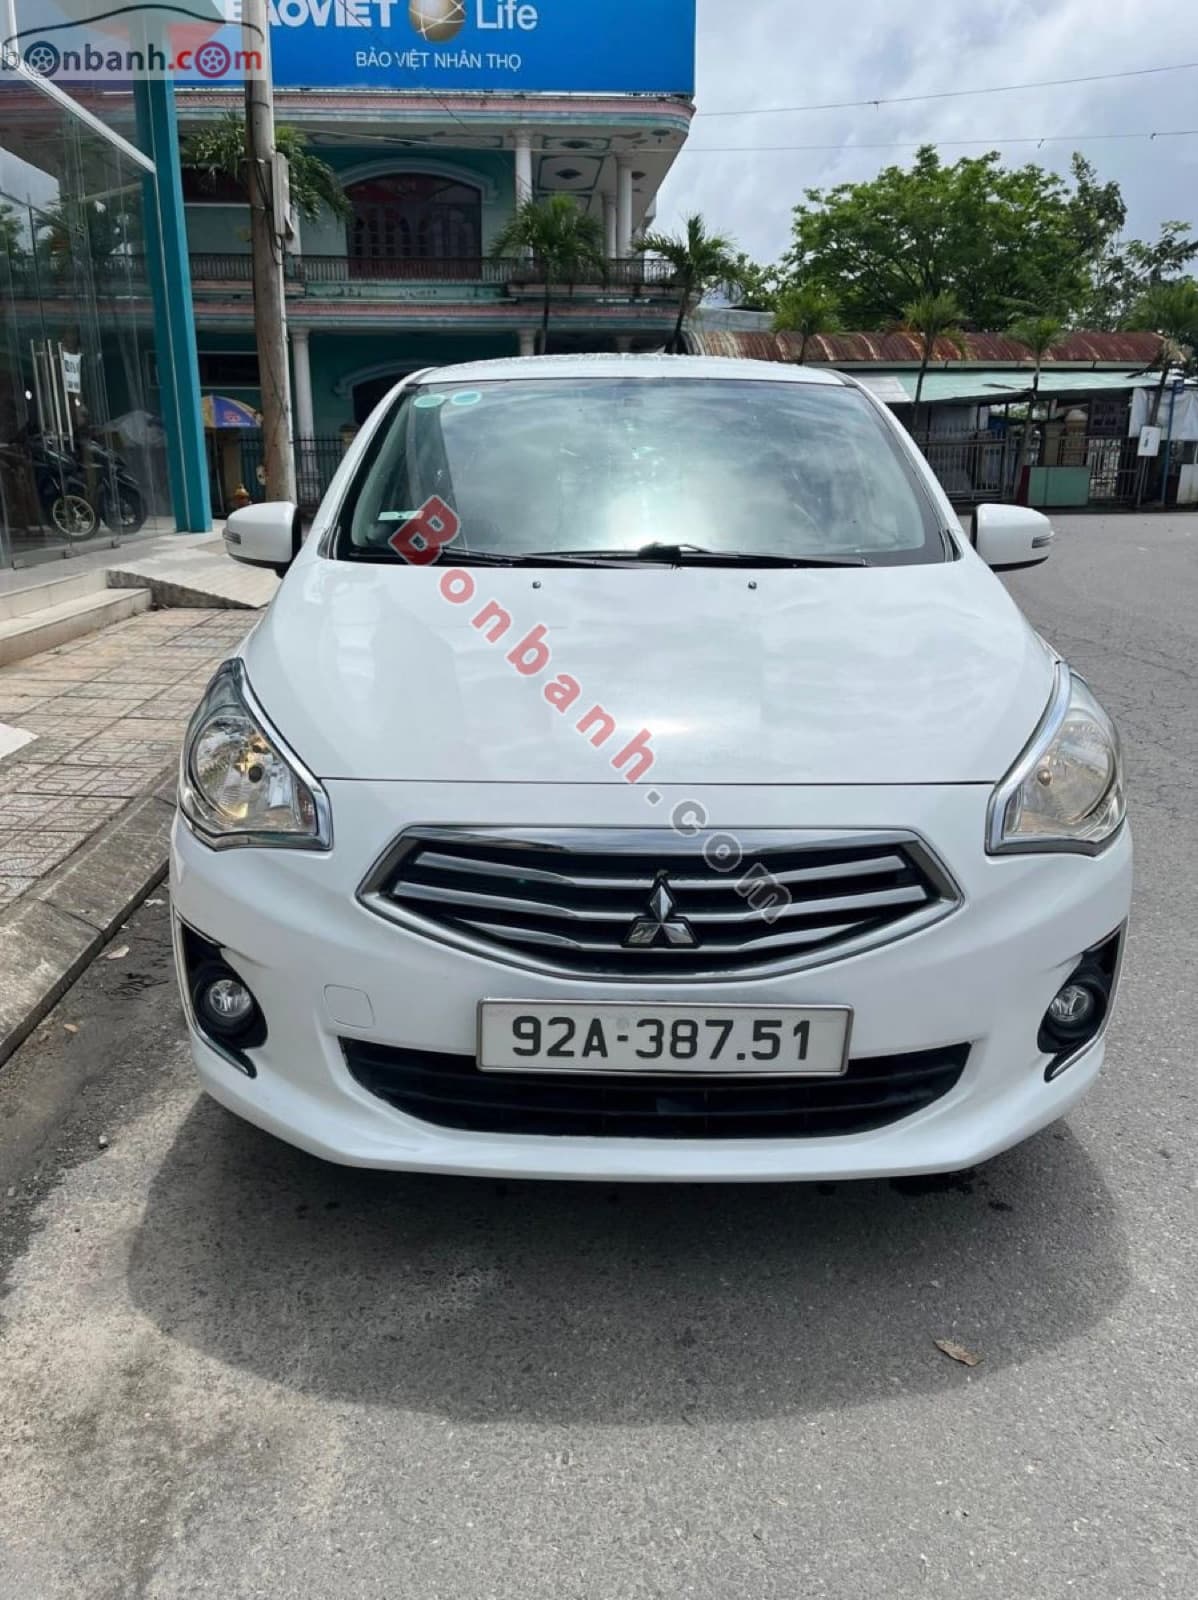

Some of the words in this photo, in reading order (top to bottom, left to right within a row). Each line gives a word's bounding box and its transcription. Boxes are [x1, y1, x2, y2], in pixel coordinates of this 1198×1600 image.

[476, 0, 538, 30] Life
[355, 47, 392, 67] BẢO
[394, 48, 429, 70] VIỆT
[434, 50, 482, 68] NHÂN
[485, 53, 522, 71] THỌ
[511, 1015, 811, 1061] 92A-387.51
